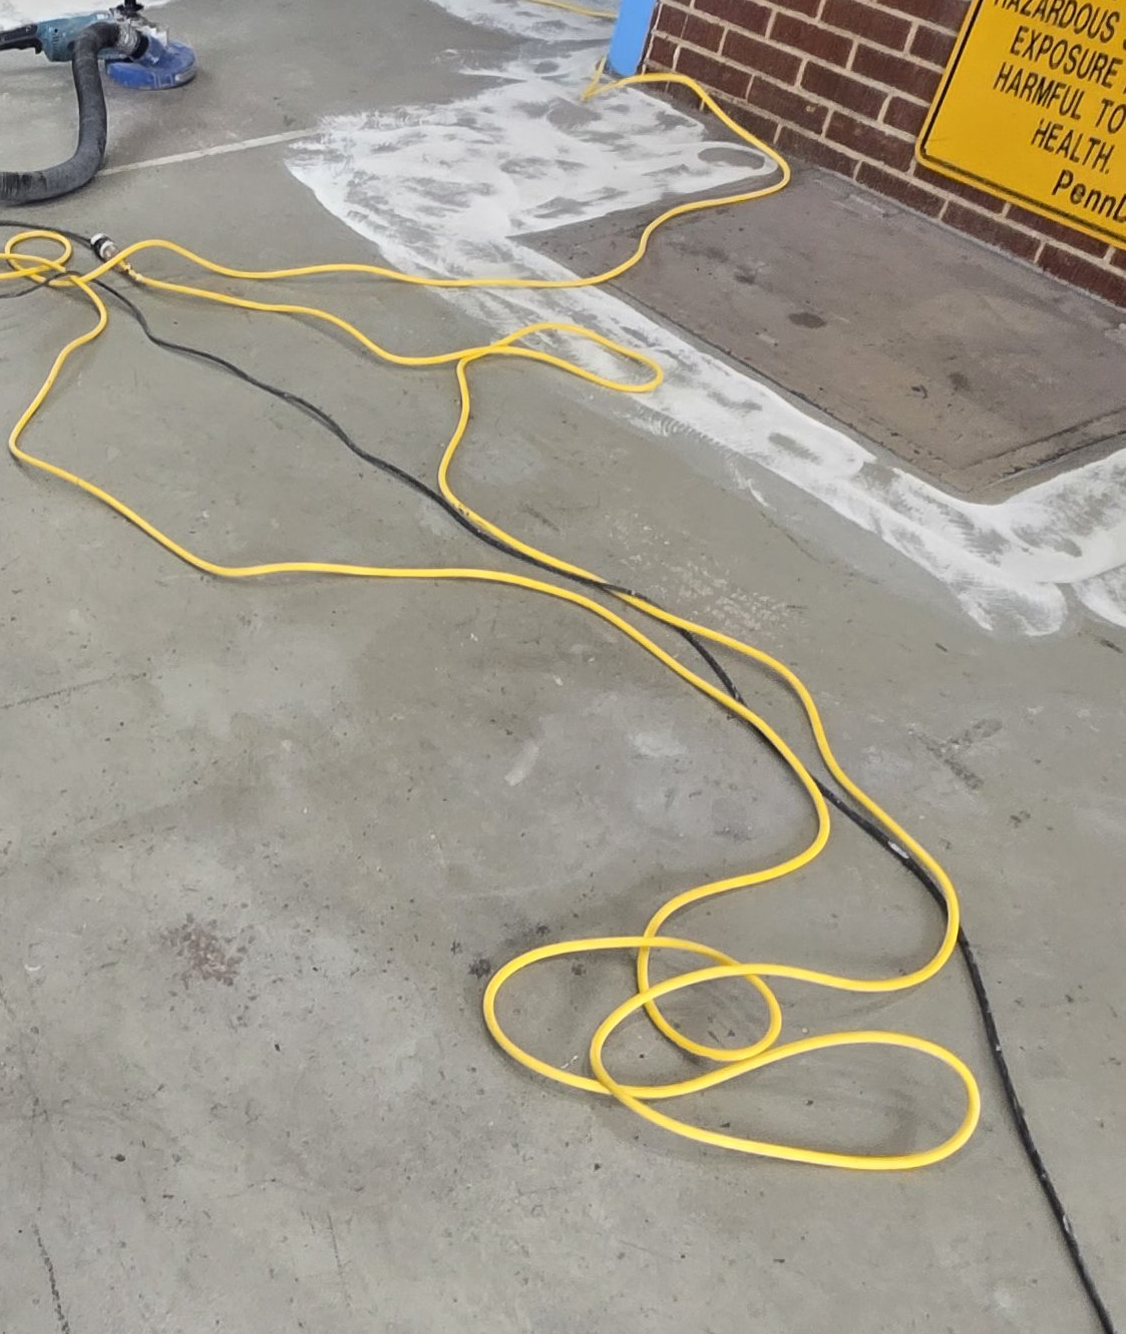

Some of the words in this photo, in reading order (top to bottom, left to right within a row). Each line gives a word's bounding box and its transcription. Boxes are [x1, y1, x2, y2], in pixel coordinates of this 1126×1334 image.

[1009, 25, 1124, 89] EXPOSURE
[993, 61, 1085, 121] HARMFUL
[1095, 98, 1126, 134] TO
[1030, 119, 1115, 175] HEALTH.
